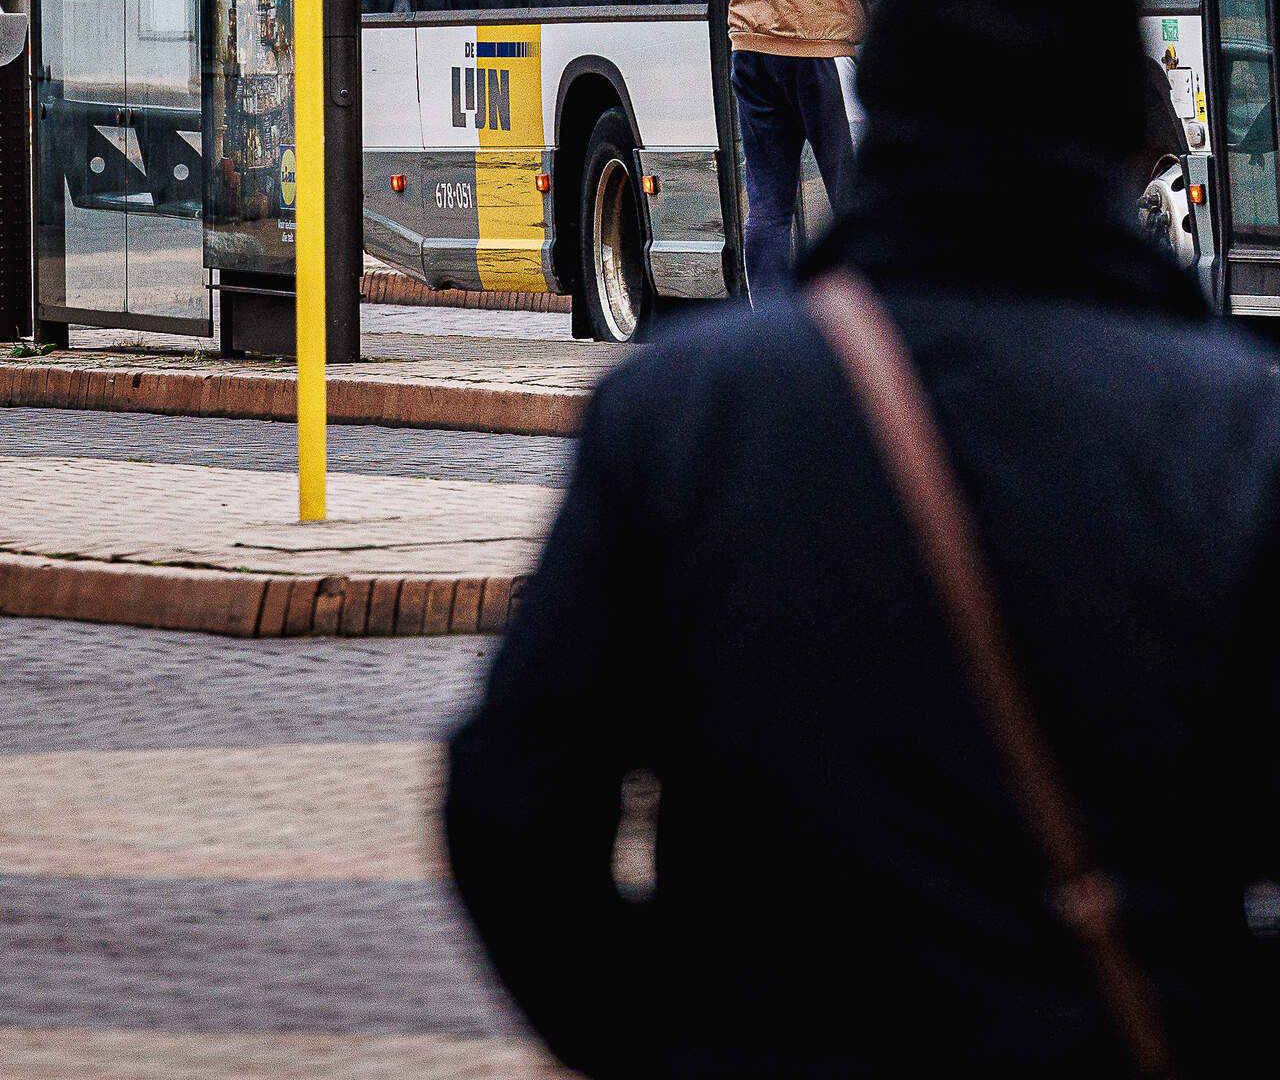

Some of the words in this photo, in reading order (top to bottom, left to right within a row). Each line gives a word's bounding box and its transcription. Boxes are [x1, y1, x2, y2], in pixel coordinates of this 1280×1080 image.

[465, 42, 474, 58] DE
[451, 66, 511, 132] LIJN
[435, 182, 472, 209] 678-051
